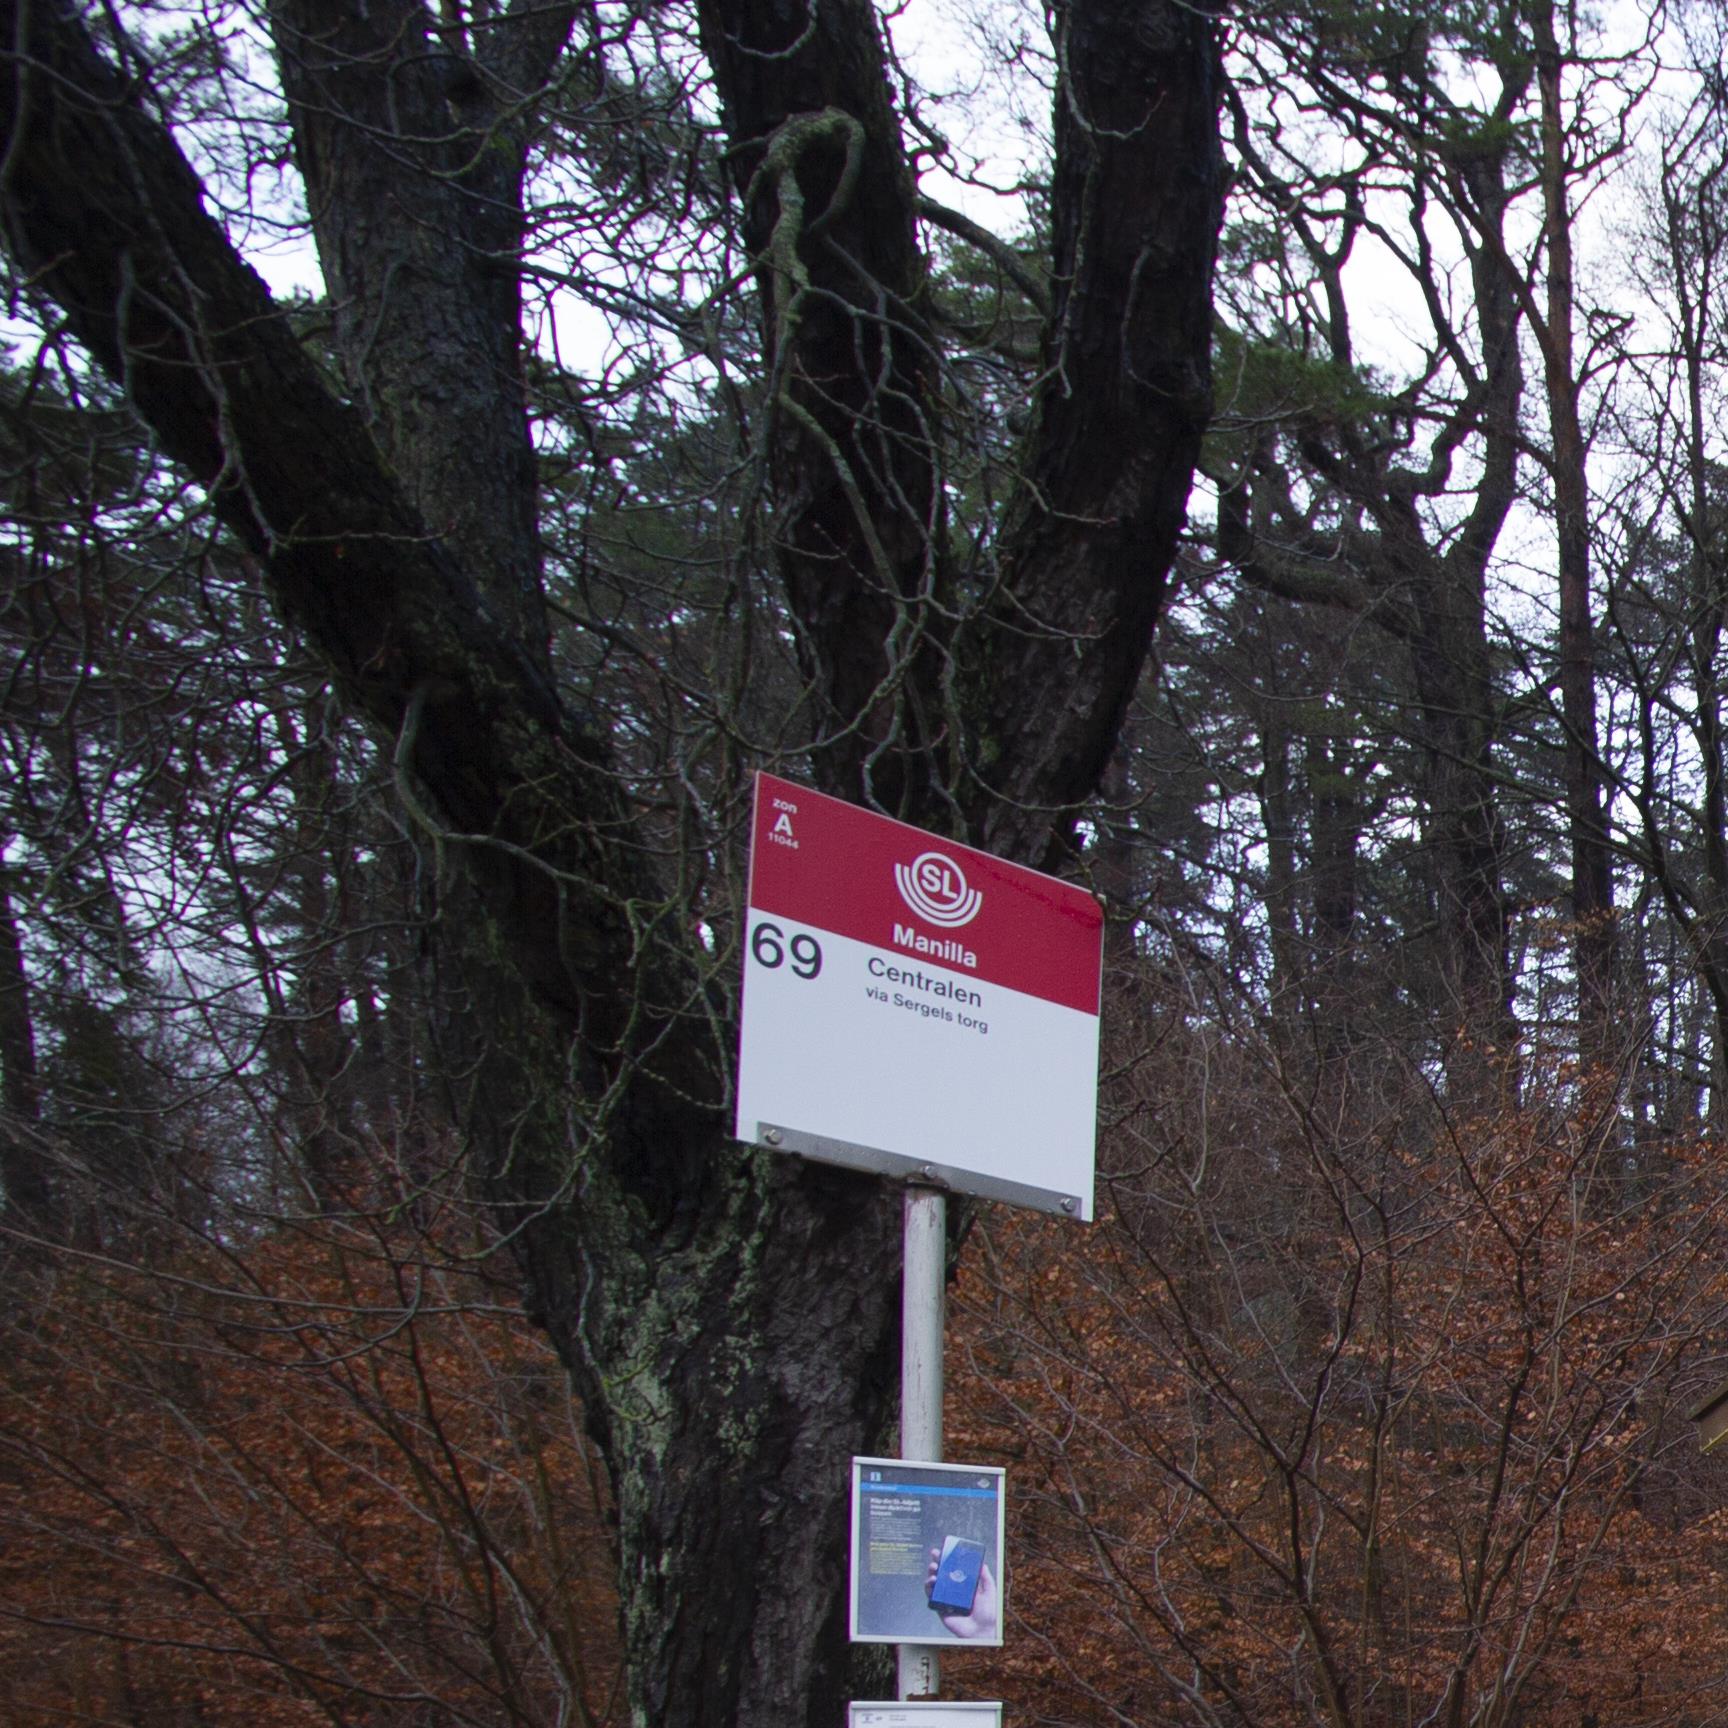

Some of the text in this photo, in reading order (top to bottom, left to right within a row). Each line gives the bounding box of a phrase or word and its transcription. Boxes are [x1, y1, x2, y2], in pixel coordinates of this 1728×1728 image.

[773, 798, 798, 814] zon
[774, 813, 793, 837] A
[921, 864, 958, 899] SL
[752, 922, 823, 979] 69
[893, 923, 977, 968] Manilla
[868, 957, 982, 1008] Centralen
[866, 986, 989, 1035] via Sergels torg
